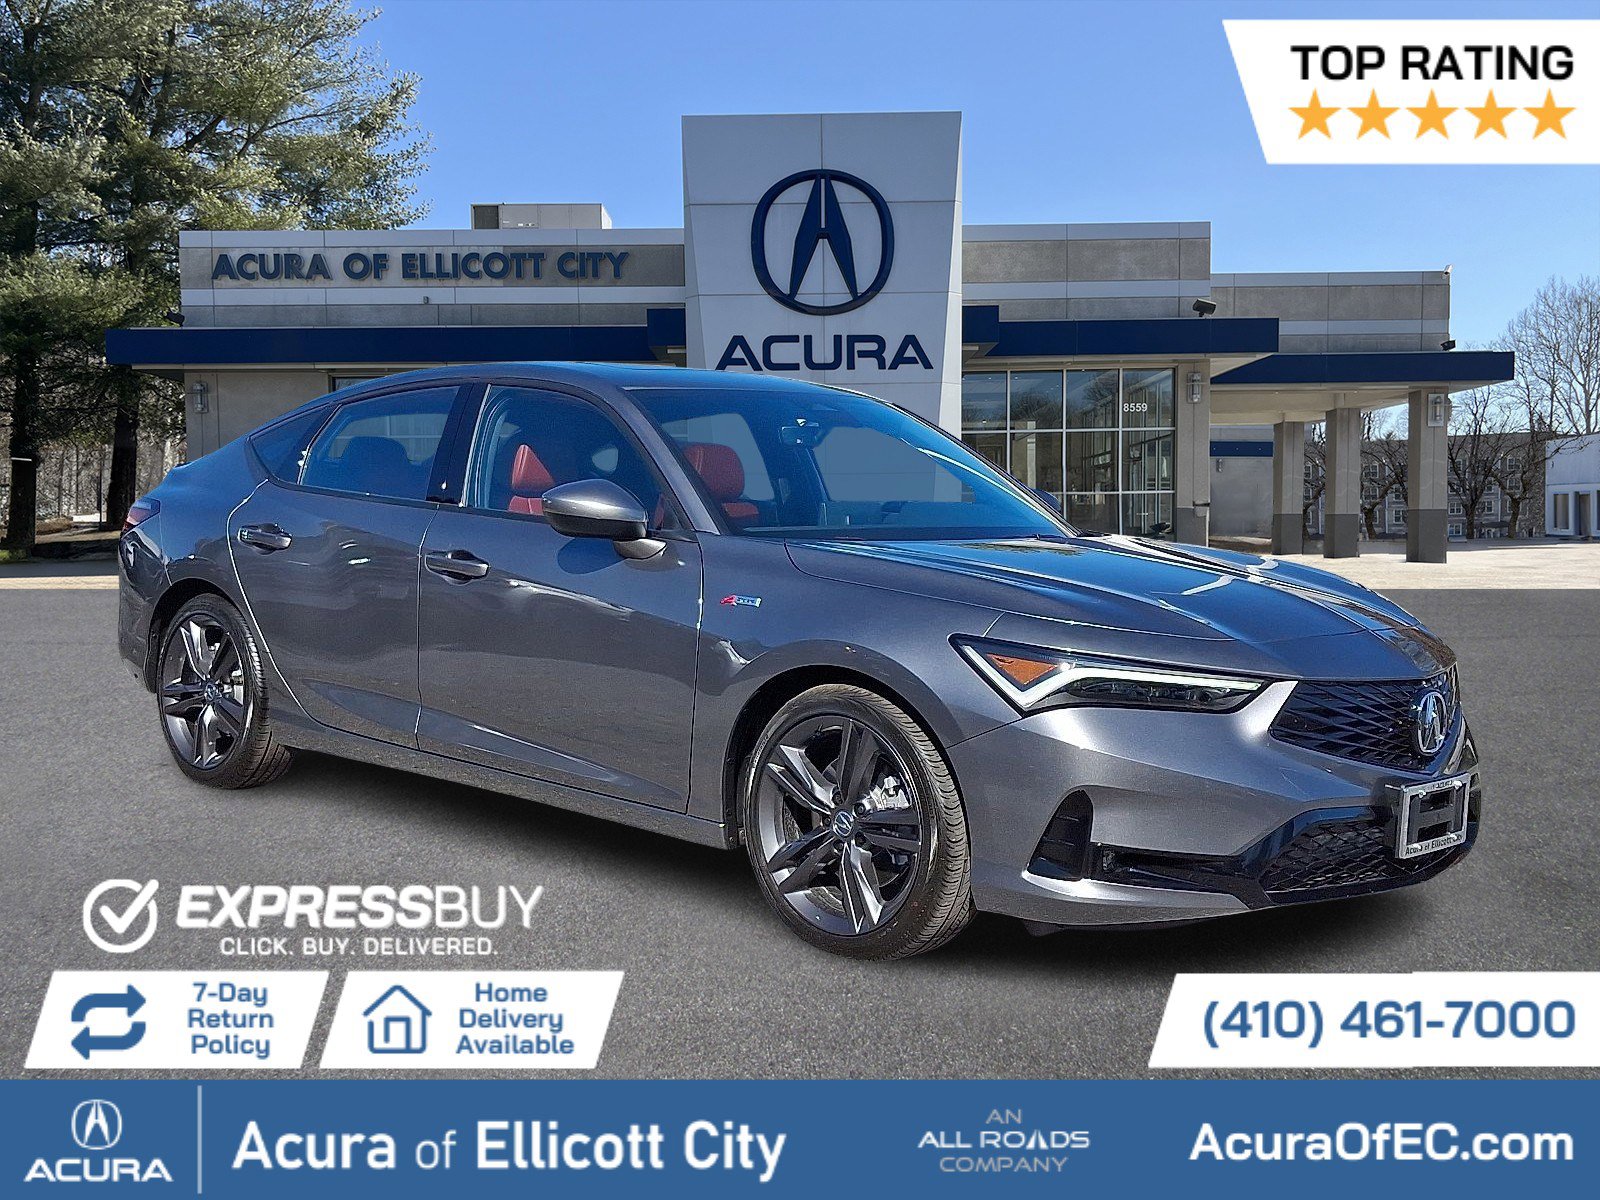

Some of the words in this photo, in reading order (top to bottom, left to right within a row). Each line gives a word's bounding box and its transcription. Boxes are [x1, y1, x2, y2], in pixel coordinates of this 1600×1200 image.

[211, 253, 332, 281] ACURA
[342, 252, 390, 280] OF
[401, 252, 547, 280] ELLICOTT
[557, 251, 629, 279] CITY
[715, 334, 934, 371] ACURA
[1123, 402, 1148, 412] 8559
